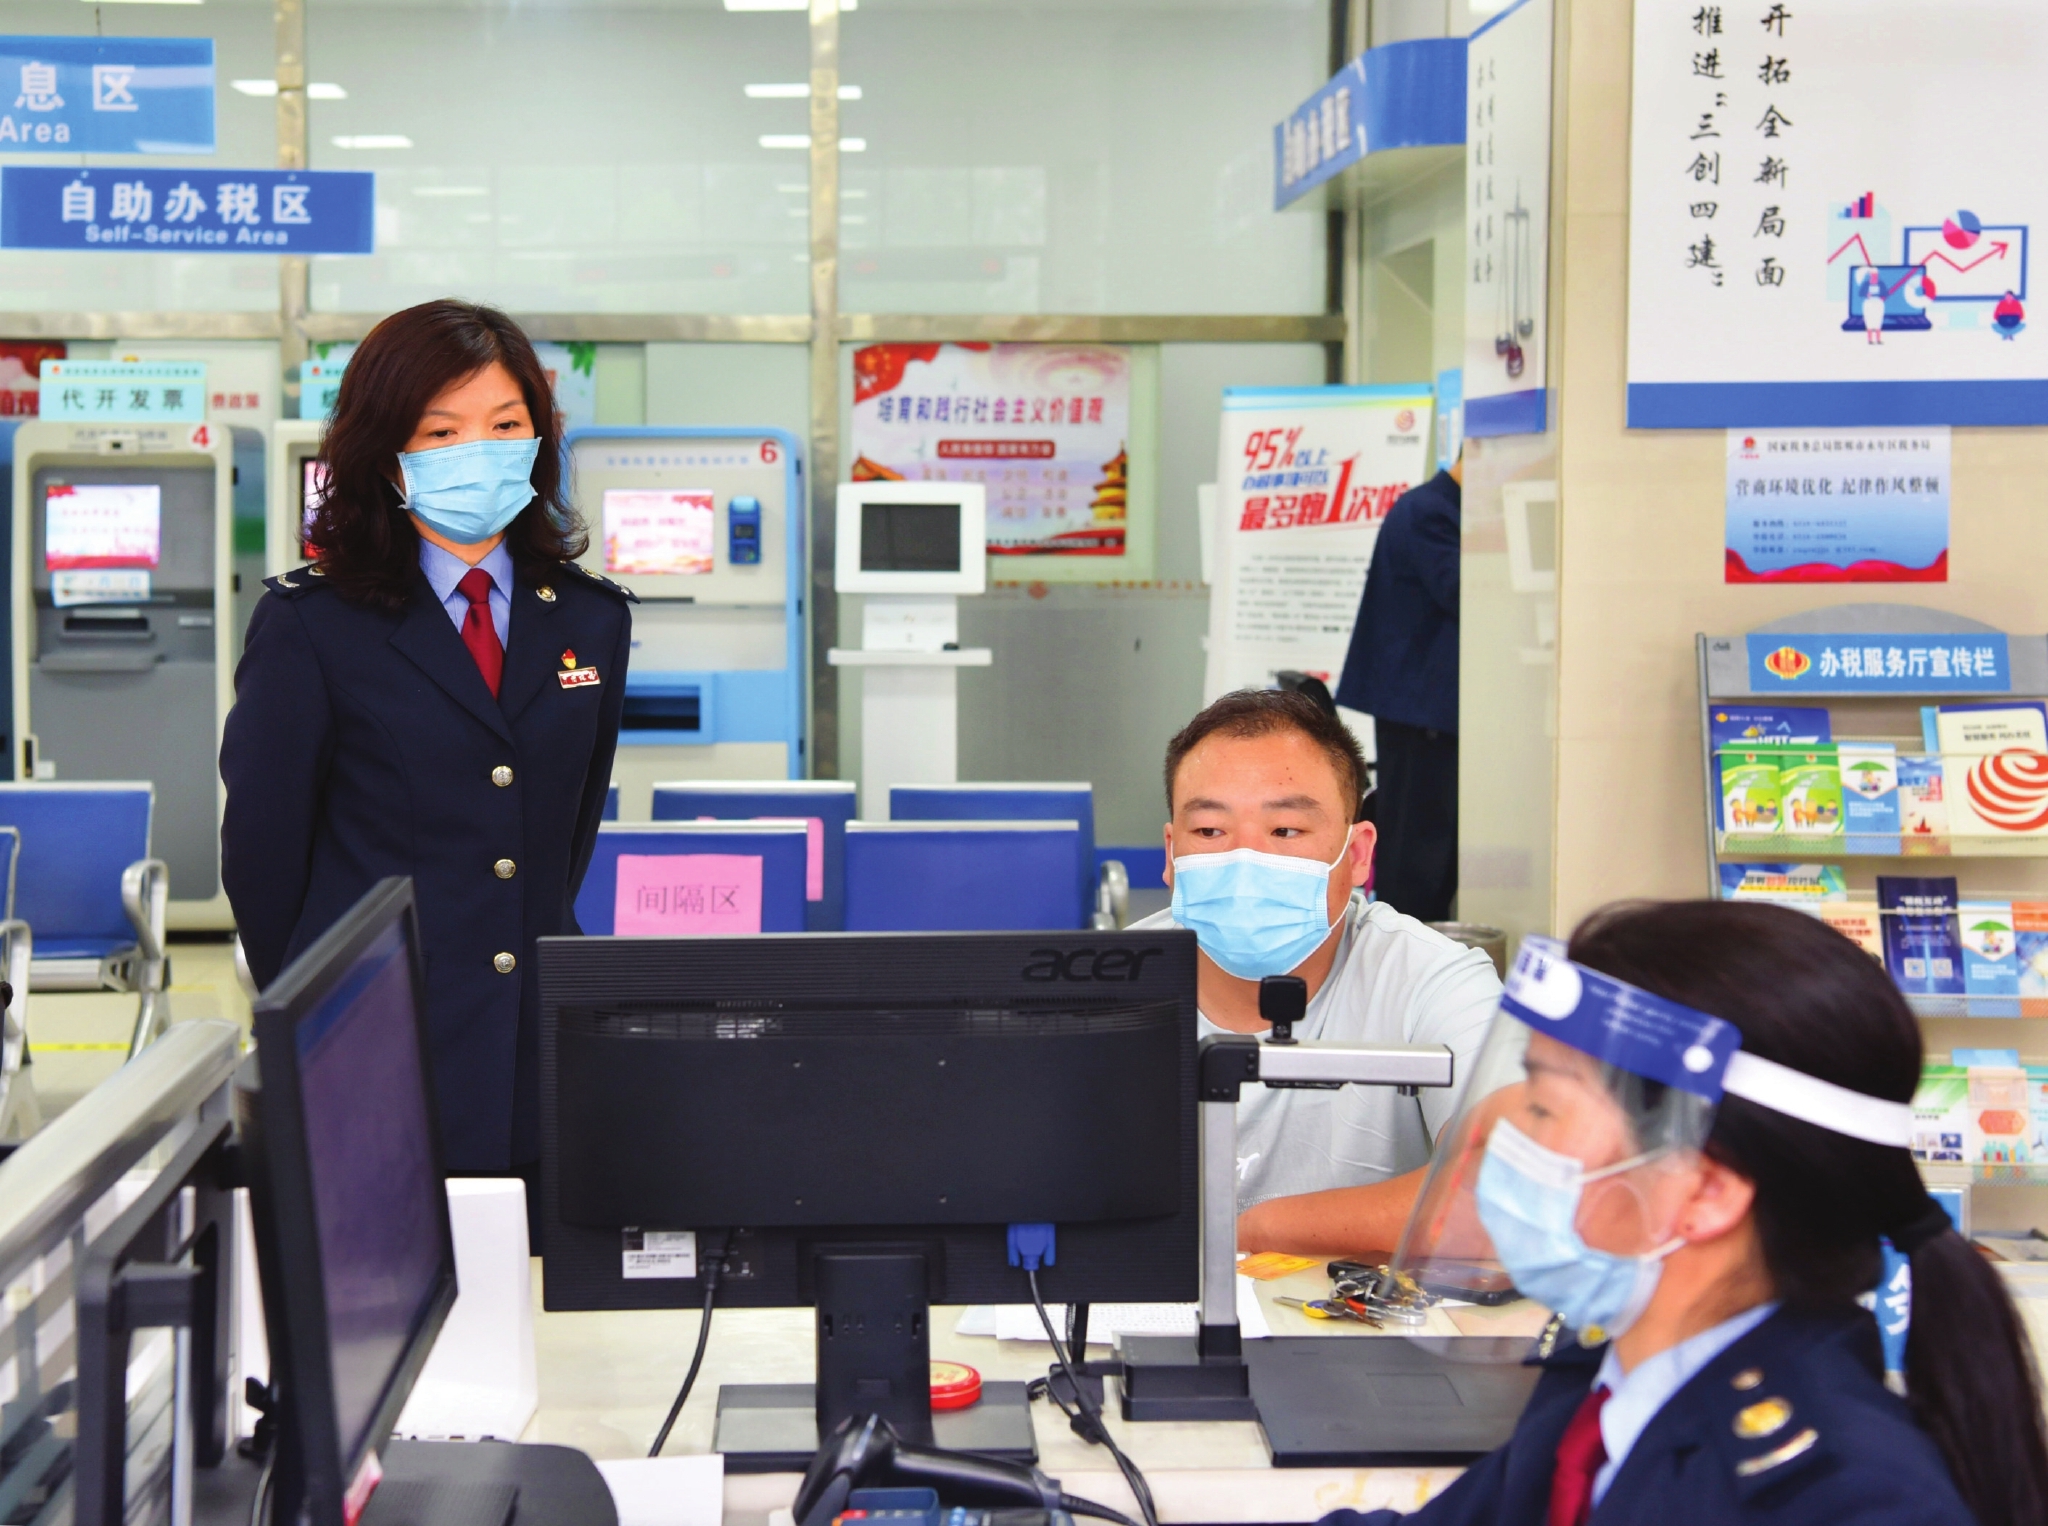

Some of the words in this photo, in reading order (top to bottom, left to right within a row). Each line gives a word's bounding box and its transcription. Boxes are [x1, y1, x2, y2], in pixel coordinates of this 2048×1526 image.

[14, 61, 139, 112] 息区
[0, 116, 71, 143] Area
[1754, 3, 1794, 288] 开拓全新局面
[62, 180, 311, 224] 自助办税区
[85, 224, 228, 245] Self-Service
[236, 226, 289, 245] Area
[62, 388, 185, 412] 代开发票
[877, 396, 1104, 424] 培育和践行社会主义价值观
[192, 425, 211, 448] 4
[759, 440, 778, 464] 6
[1735, 477, 1834, 496] 营商环境优化
[1841, 475, 1940, 496] 纪律作风整顿
[1819, 647, 1998, 679] 办税服务厅宣传栏
[636, 883, 740, 915] 间隔区
[1021, 948, 1165, 982] acer
